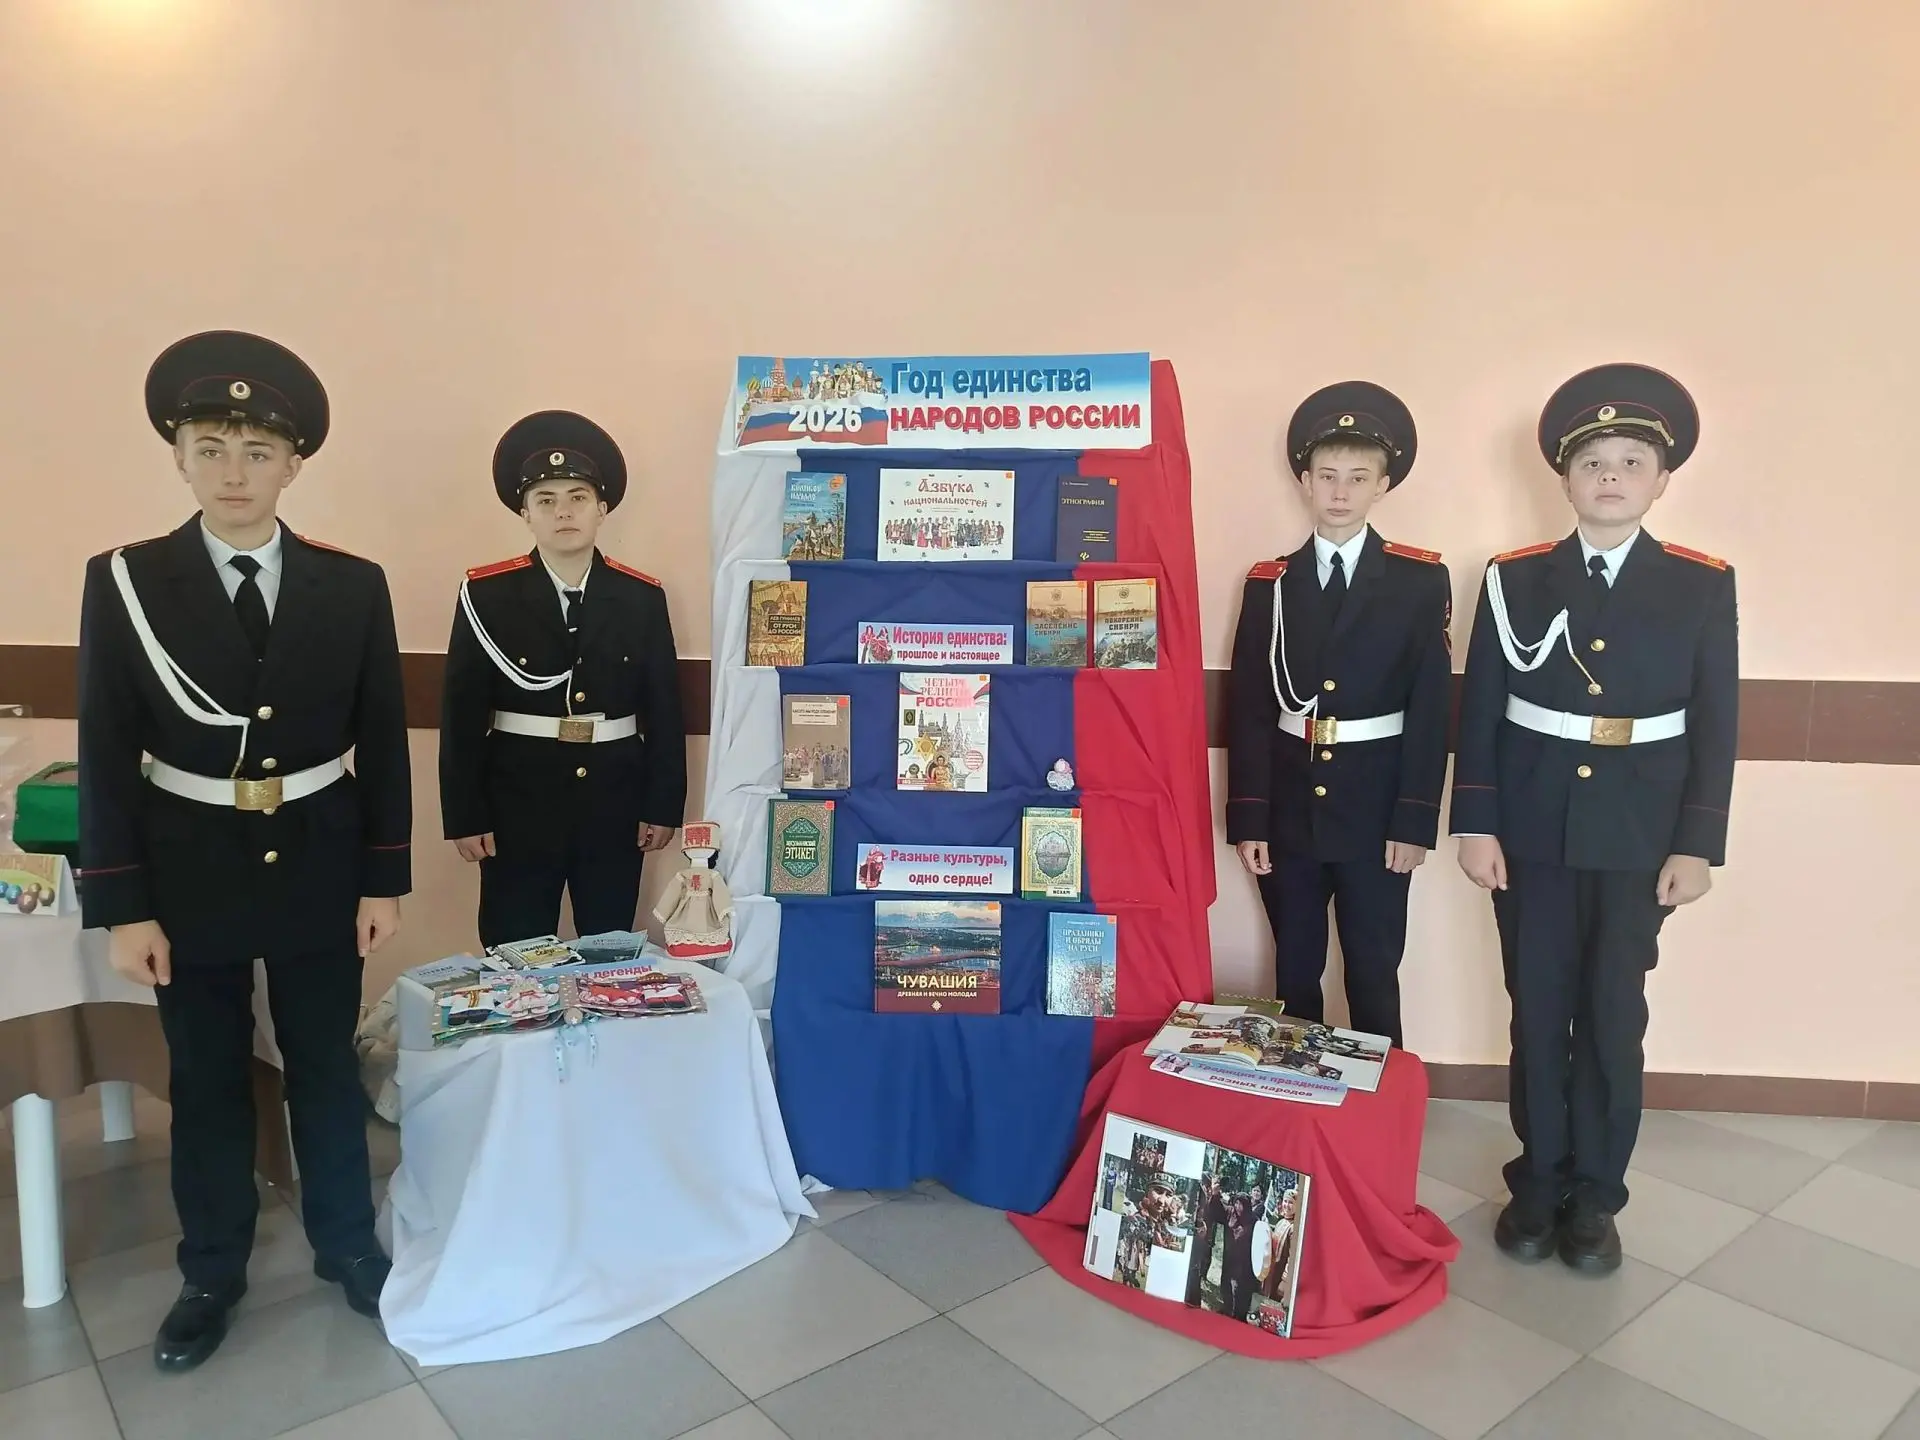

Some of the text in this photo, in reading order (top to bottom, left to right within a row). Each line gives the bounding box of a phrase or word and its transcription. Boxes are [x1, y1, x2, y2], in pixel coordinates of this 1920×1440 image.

[891, 362, 1092, 399] Год единства
[788, 404, 862, 433] 2026
[890, 404, 1141, 434] НАРОДОВ РОССИИ
[1061, 497, 1105, 506] ЭТНОГРАФИЯ
[1034, 622, 1078, 630] ЗАСЕЛЕНИЕ
[1108, 623, 1139, 631] СИБИРИ
[893, 626, 1007, 648] История единства:
[897, 649, 1000, 662] прошлое и настоящее
[784, 847, 816, 860] ЭТИКЕТ
[890, 849, 1008, 867] Разные культуры,
[908, 873, 993, 887] одно сердце!
[1062, 928, 1105, 938] ПРАЗДНИКИ
[1079, 944, 1098, 952] РУСИ
[593, 964, 653, 979] легенды
[897, 974, 978, 989] ЧУВАШИЯ
[1196, 1062, 1340, 1093] Традиции и праздники
[1208, 1074, 1313, 1098] разных народов
